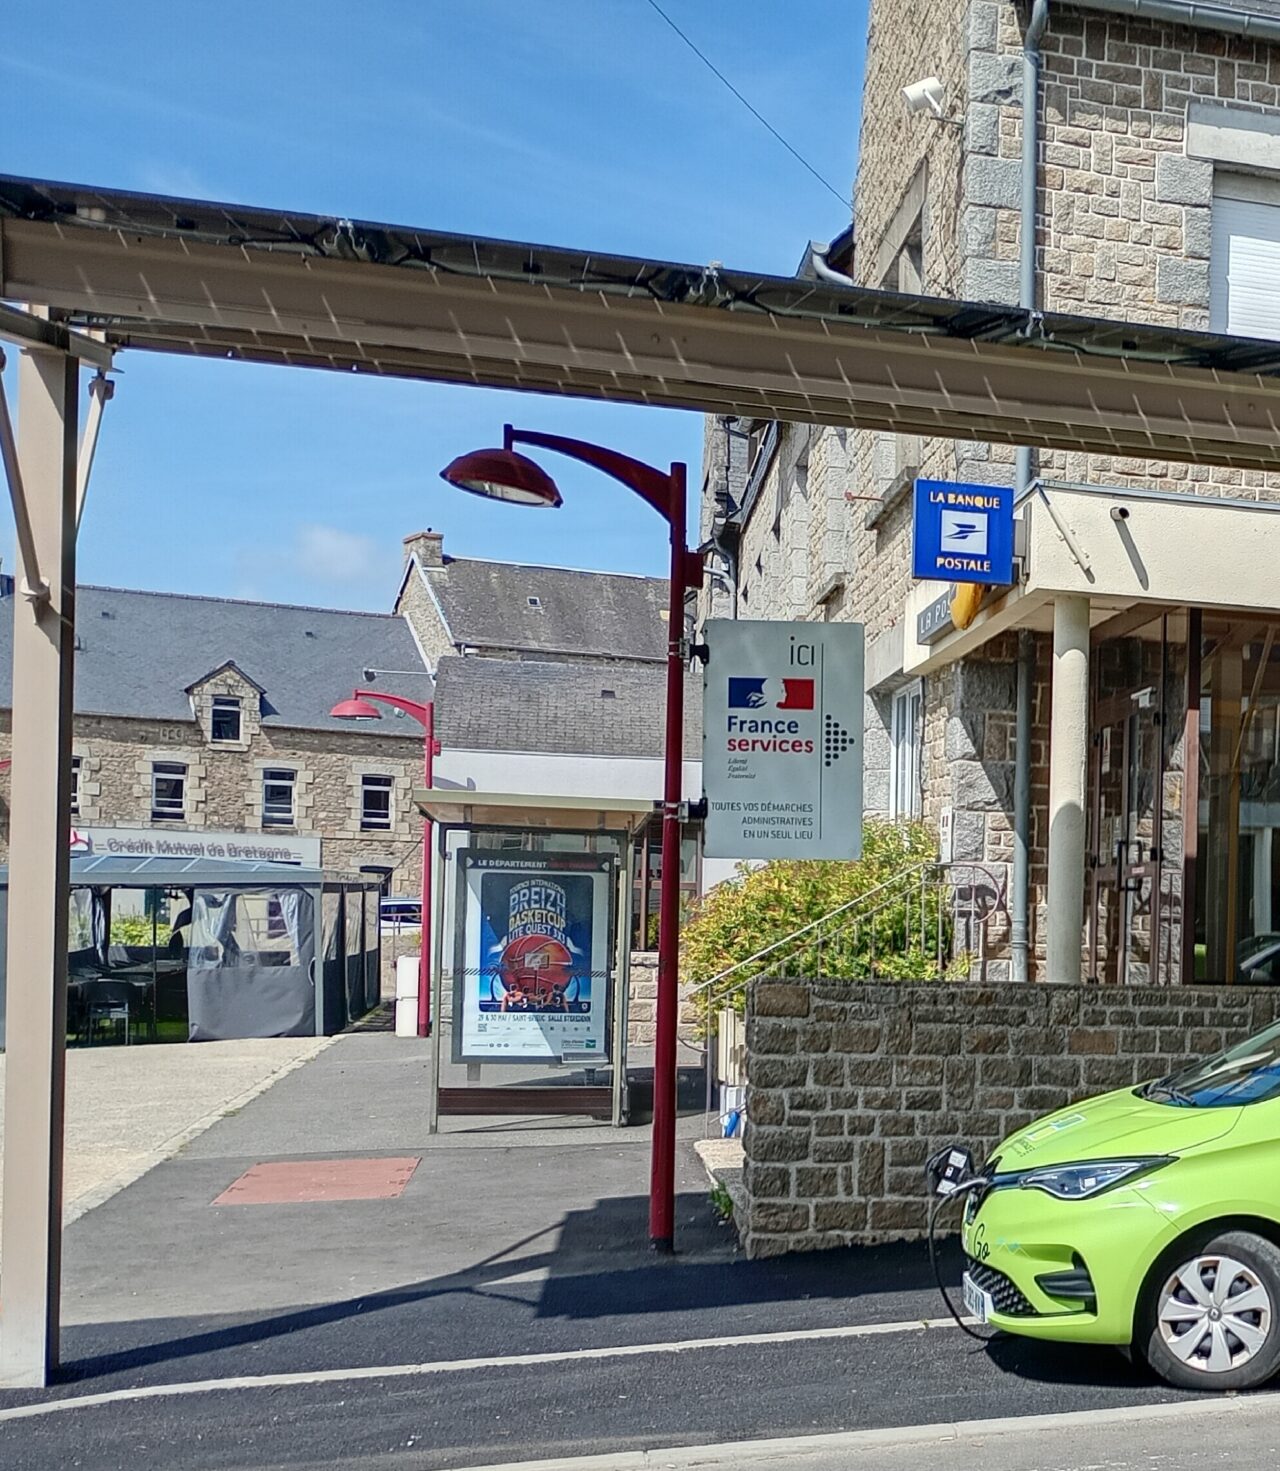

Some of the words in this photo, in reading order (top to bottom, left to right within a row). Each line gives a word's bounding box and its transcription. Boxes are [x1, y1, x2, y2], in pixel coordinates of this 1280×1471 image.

[929, 491, 945, 503] LA
[947, 494, 1001, 509] BANQUE
[936, 556, 991, 572] POSTALE
[920, 613, 931, 634] LA
[728, 715, 799, 734] France
[727, 735, 814, 753] services
[711, 802, 741, 811] TOUTES
[743, 802, 759, 811] VOS
[761, 801, 813, 813] DÉMARCHES
[741, 816, 813, 826] ADMINISTRATIVES
[744, 829, 755, 838] EN
[757, 830, 769, 838] UN
[771, 830, 792, 839] SEUL
[794, 830, 813, 840] LIEU
[107, 838, 154, 853] Crédit
[156, 840, 205, 856] Mutuel
[207, 843, 225, 857] de
[227, 843, 292, 860] Bretagne
[478, 859, 488, 867] LE
[489, 859, 547, 869] DÉPARTEMENT
[509, 887, 567, 921] BREIZH
[973, 1223, 990, 1260] Go
